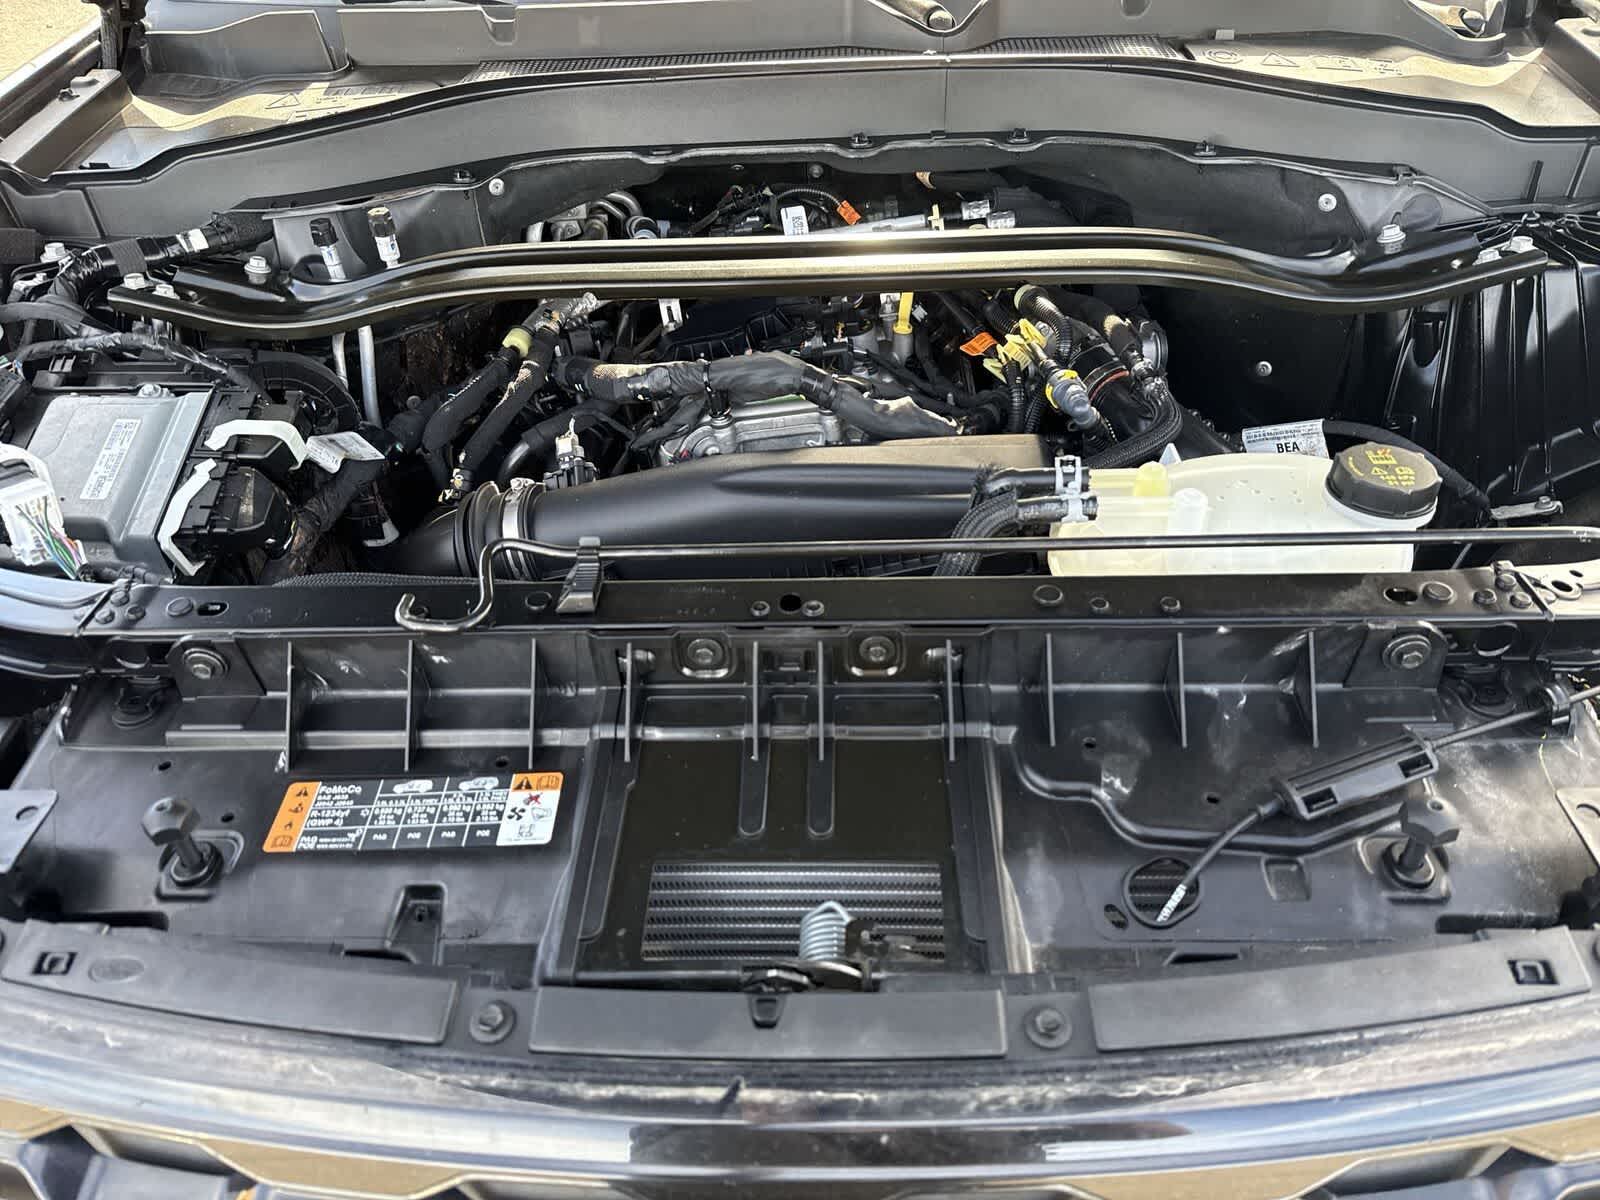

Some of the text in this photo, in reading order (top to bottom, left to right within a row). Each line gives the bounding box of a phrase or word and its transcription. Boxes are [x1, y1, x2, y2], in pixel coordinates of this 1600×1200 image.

[1276, 441, 1300, 453] BEA
[319, 785, 362, 794] FoMoCo
[310, 809, 351, 818] R-1234yf
[306, 818, 334, 828] (GWP
